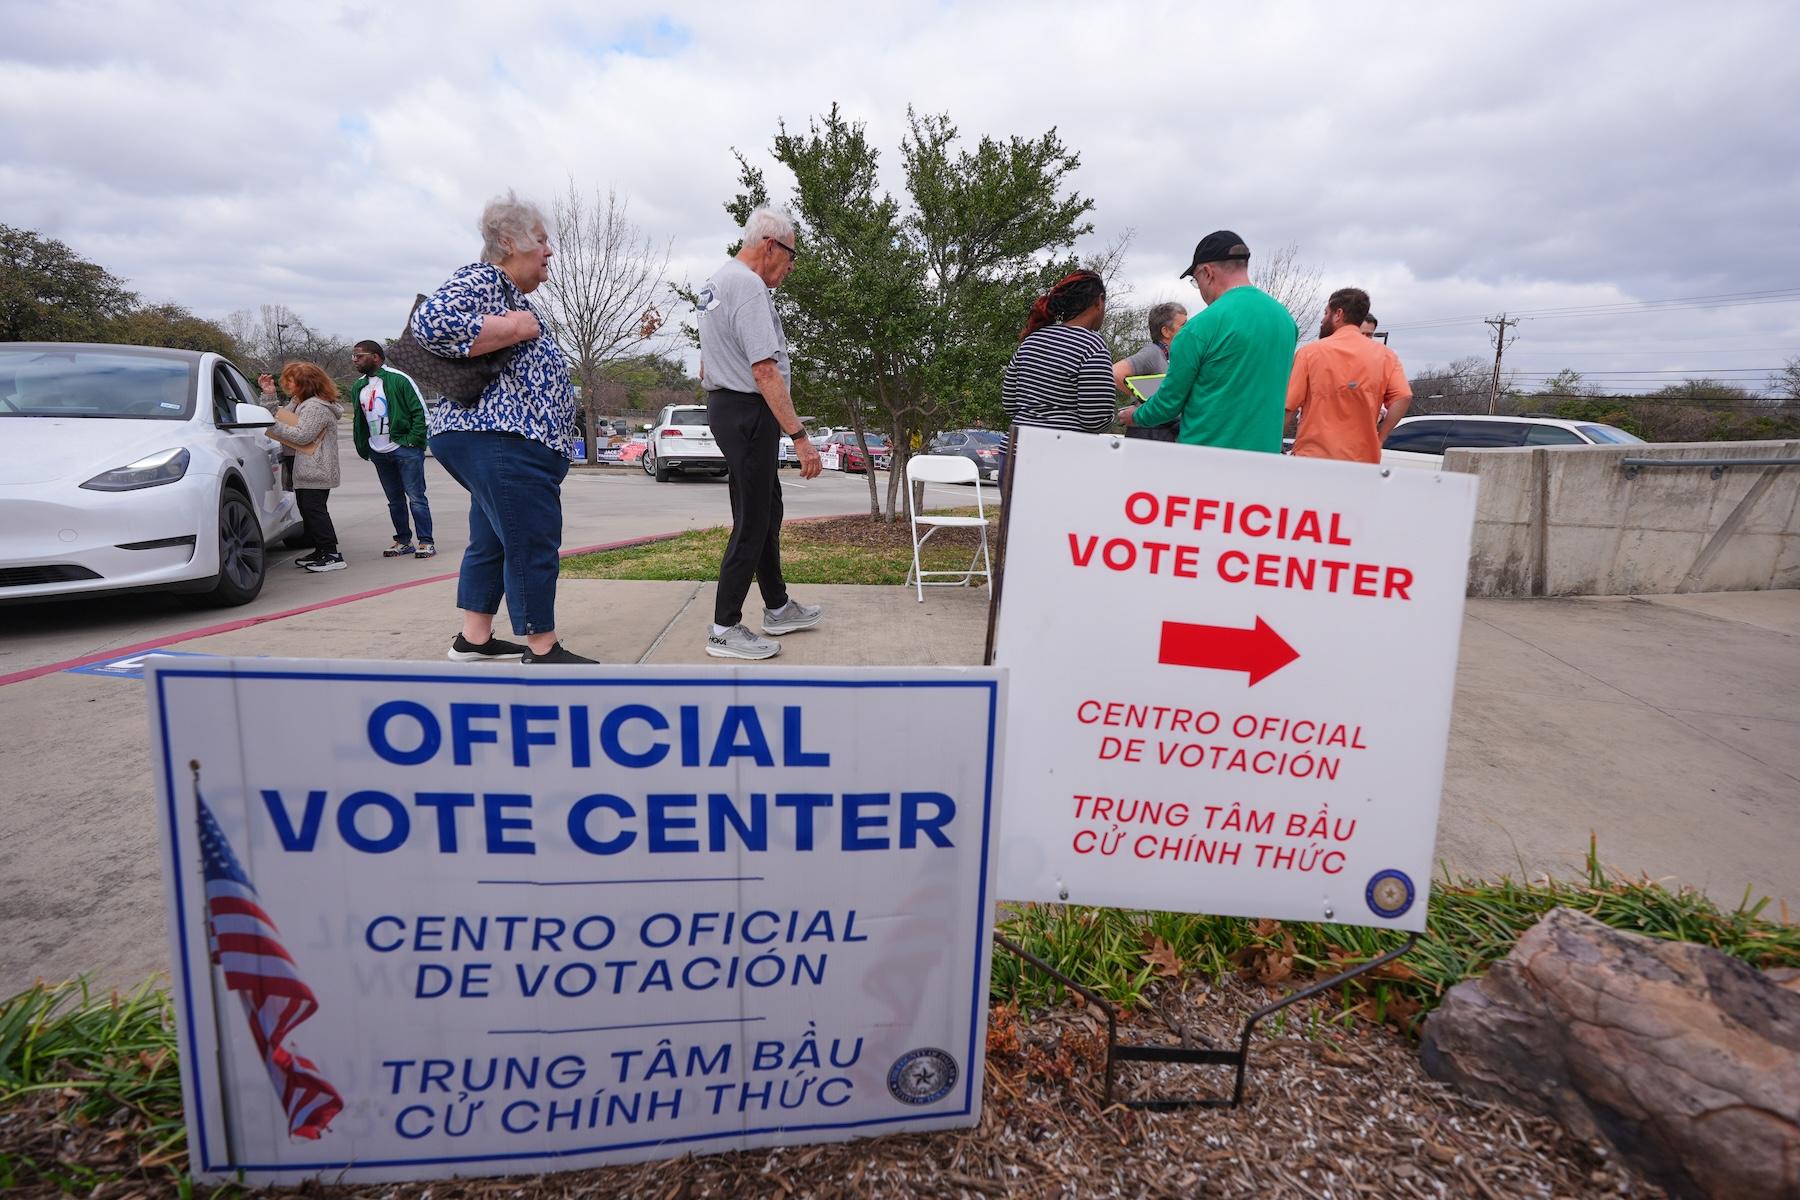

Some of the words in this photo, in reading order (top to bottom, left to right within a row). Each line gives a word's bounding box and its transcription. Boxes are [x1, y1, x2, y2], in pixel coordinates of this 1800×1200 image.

[1124, 491, 1352, 546] OFFICIAL
[1068, 532, 1200, 579] VOTE
[1216, 549, 1415, 600] CENTER
[367, 699, 832, 769] OFFICIAL
[1077, 699, 1221, 736] CENTRO
[1233, 713, 1368, 750] OFICIAL
[1098, 736, 1147, 763] DE
[1158, 741, 1341, 781] VOTACIÓN
[260, 787, 538, 855] VOTE
[567, 791, 957, 856] CENTER
[1072, 795, 1190, 828] TRUNG
[1204, 801, 1276, 835] TÂM
[1285, 803, 1357, 842] BẦU
[1072, 824, 1127, 857] CỬ
[1133, 832, 1243, 867] CHÍNH
[1255, 844, 1347, 875] THỨC
[365, 914, 616, 952] CENTRO
[639, 909, 869, 948] OFICIAL
[414, 962, 493, 998] DE
[516, 947, 829, 998] VOTACIÓN
[382, 1054, 587, 1094] TRUNG
[611, 1038, 731, 1082] TÂM
[752, 1020, 864, 1071] BẦU
[395, 1091, 484, 1139] CỬ
[500, 1087, 682, 1134] CHÍNH
[710, 1072, 853, 1114] THỨC
